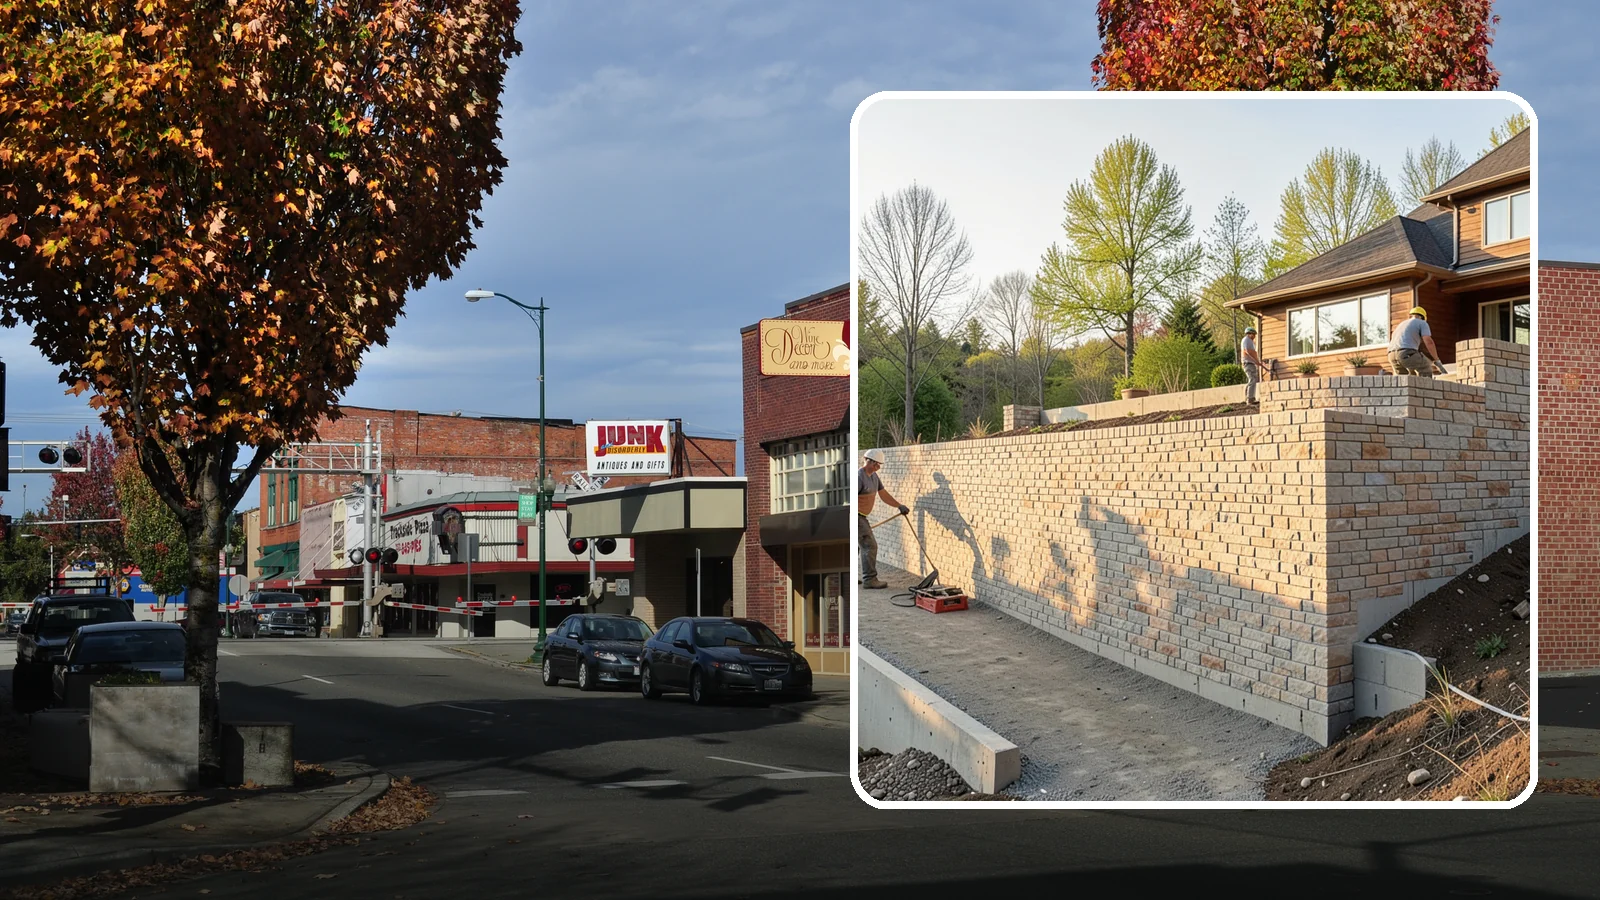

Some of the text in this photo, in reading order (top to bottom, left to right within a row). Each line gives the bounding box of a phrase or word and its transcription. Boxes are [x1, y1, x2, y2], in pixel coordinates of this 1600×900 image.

[595, 425, 665, 457] JUNK
[607, 446, 646, 454] DISORDERLY
[596, 460, 666, 470] ANTIQUES AND GIFTS
[390, 519, 429, 540] Trackside Pizza
